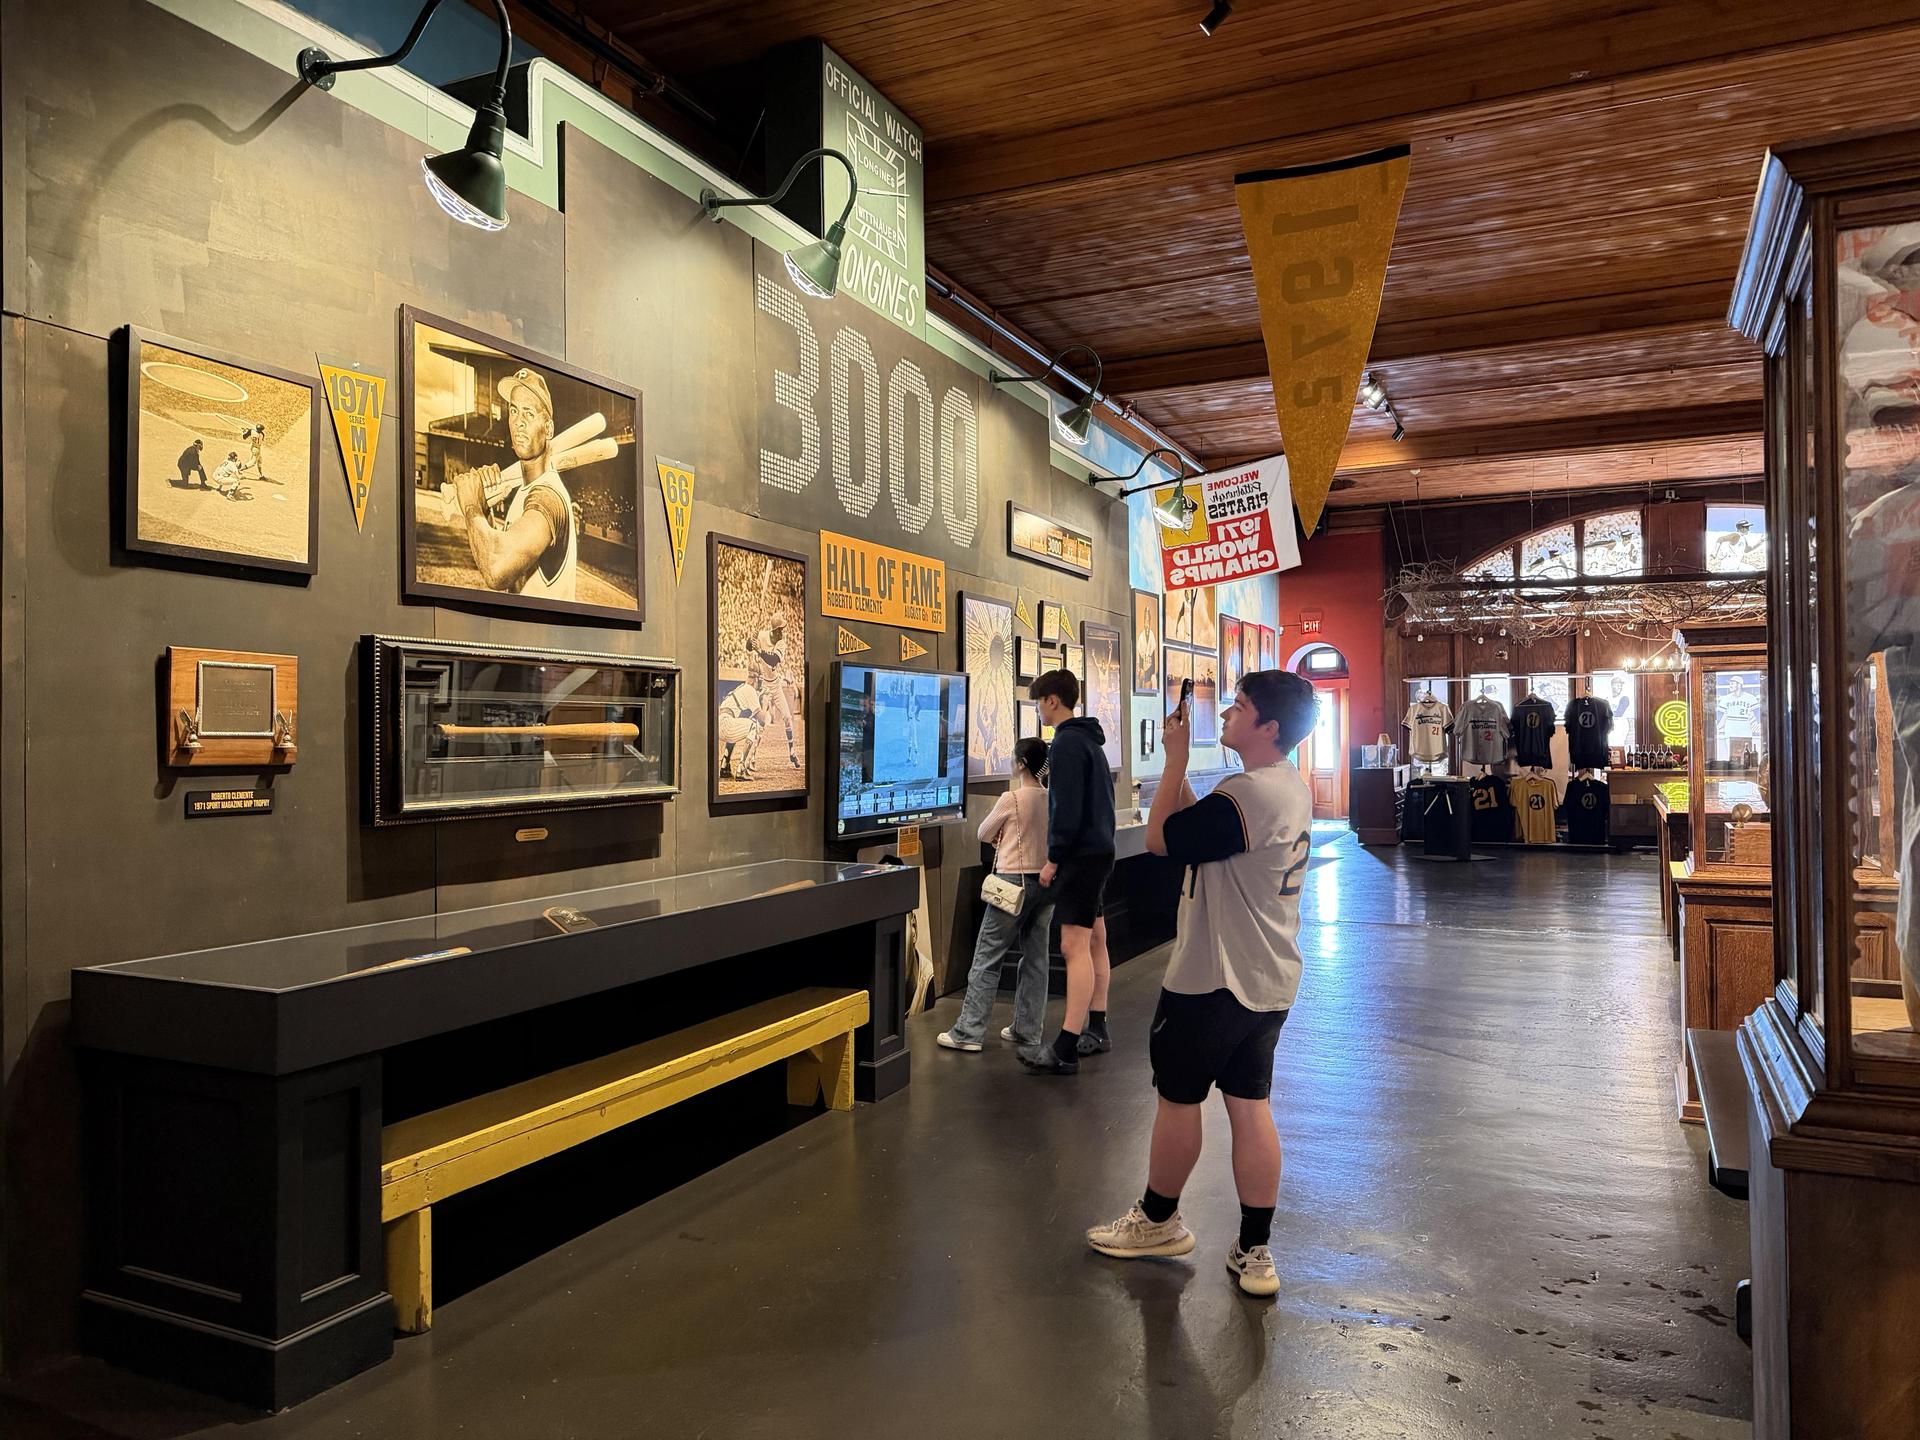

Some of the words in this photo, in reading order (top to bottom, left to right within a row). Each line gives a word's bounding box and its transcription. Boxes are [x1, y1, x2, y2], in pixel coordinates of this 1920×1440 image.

[825, 61, 879, 128] OFFICIAL
[885, 111, 922, 164] WATCH
[858, 151, 895, 188] LONGINES
[857, 204, 897, 242] WITTNAUER
[836, 242, 920, 328] ONGINES
[330, 372, 379, 418] 1971
[348, 415, 366, 425] SERIES
[757, 273, 978, 548] 3000
[665, 470, 689, 507] 66
[826, 543, 870, 597] HALL
[876, 556, 896, 600] OF
[902, 561, 941, 610] FAME
[827, 591, 852, 610] ROBERTO
[855, 597, 883, 614] CLEMENTE
[904, 605, 920, 620] AUGUST
[931, 610, 942, 624] 1973
[1303, 620, 1320, 633] EXIT
[840, 630, 857, 651] 3000
[1581, 713, 1593, 726] 21
[1664, 709, 1688, 730] 21
[1431, 726, 1440, 736] 21
[1664, 736, 1689, 747] Shop
[194, 802, 206, 811] 1971
[220, 800, 243, 809] MAGAZINE
[211, 792, 231, 800] ROBERTO
[231, 791, 254, 800] CLEMENTE
[1472, 786, 1499, 810] 21
[1530, 796, 1543, 809] 21
